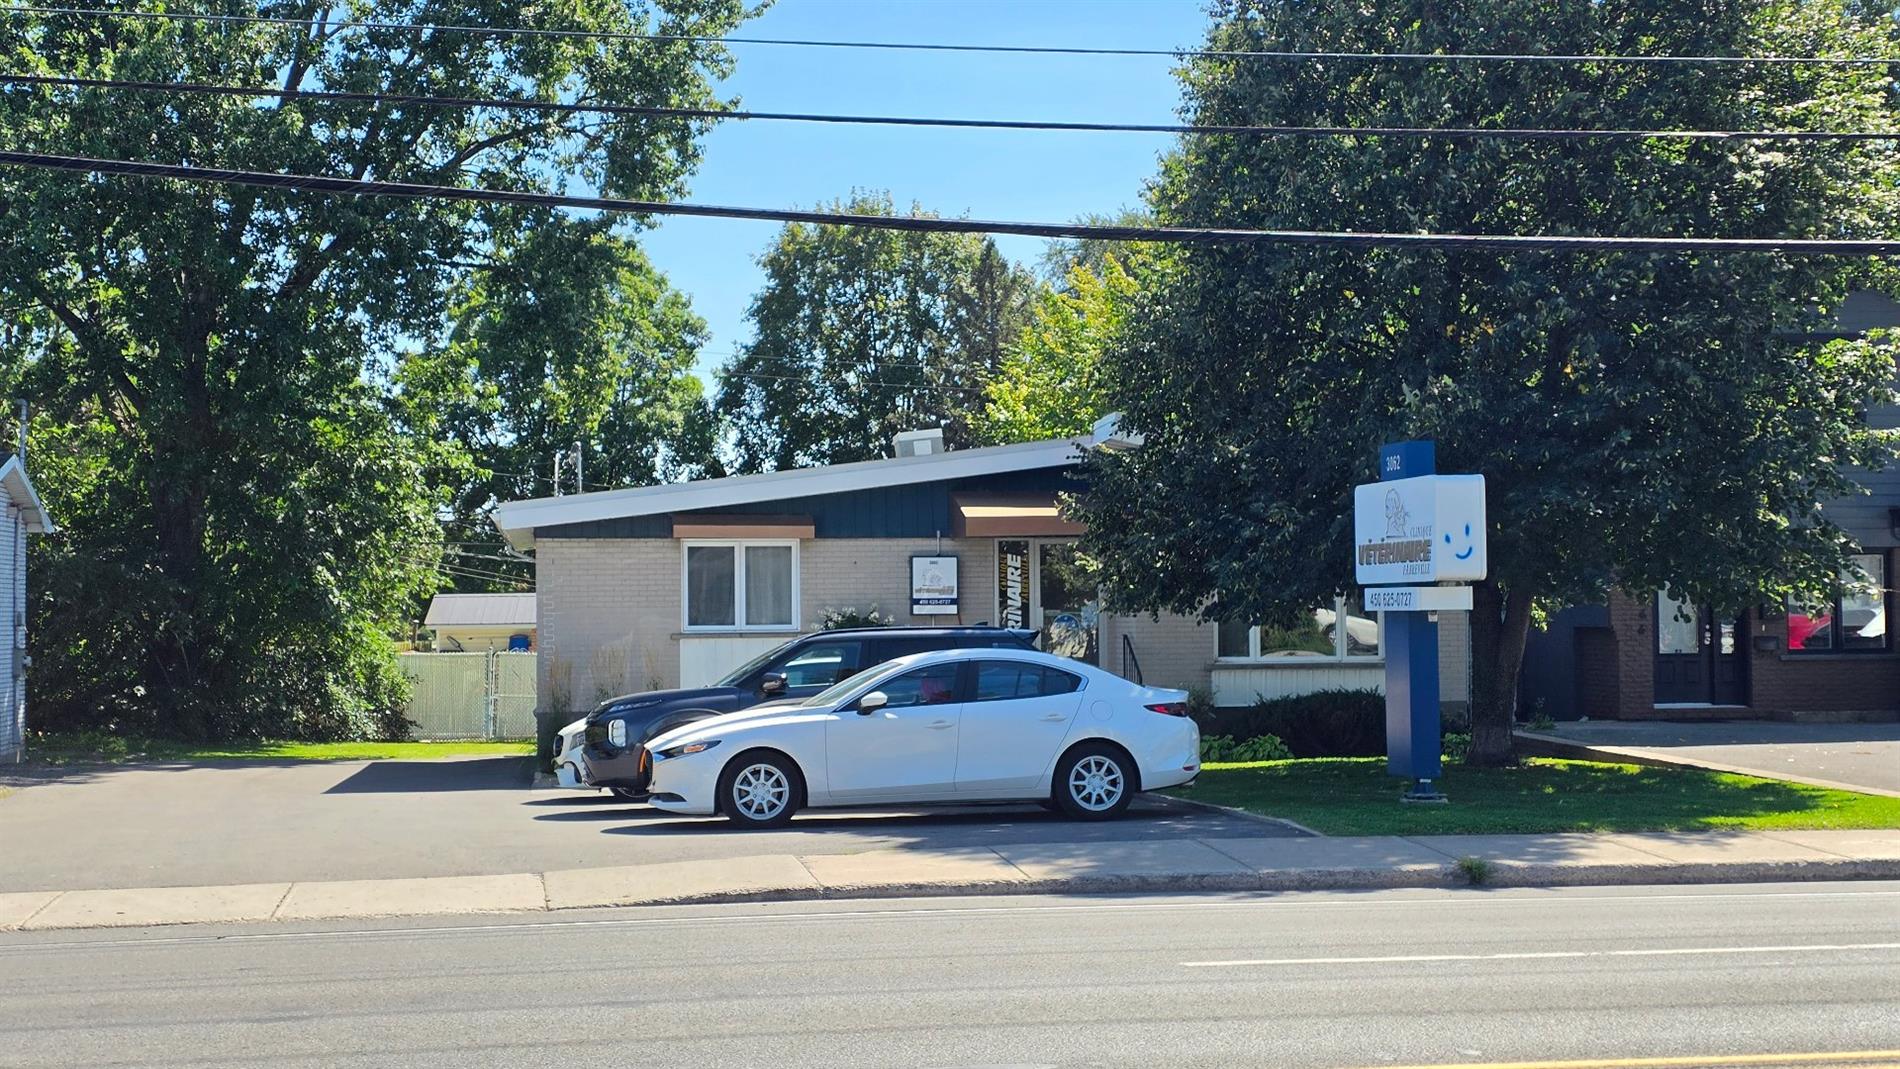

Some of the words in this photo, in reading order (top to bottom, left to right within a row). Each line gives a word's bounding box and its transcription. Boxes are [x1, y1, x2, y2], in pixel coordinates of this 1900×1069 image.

[1386, 454, 1401, 472] 3062
[1409, 525, 1433, 538] CLINIQUE
[1358, 537, 1433, 566] VÉTÉRINAIRE
[1006, 553, 1022, 629] RINAIRE
[1370, 593, 1381, 607] 450
[1383, 592, 1412, 607] 625-0727
